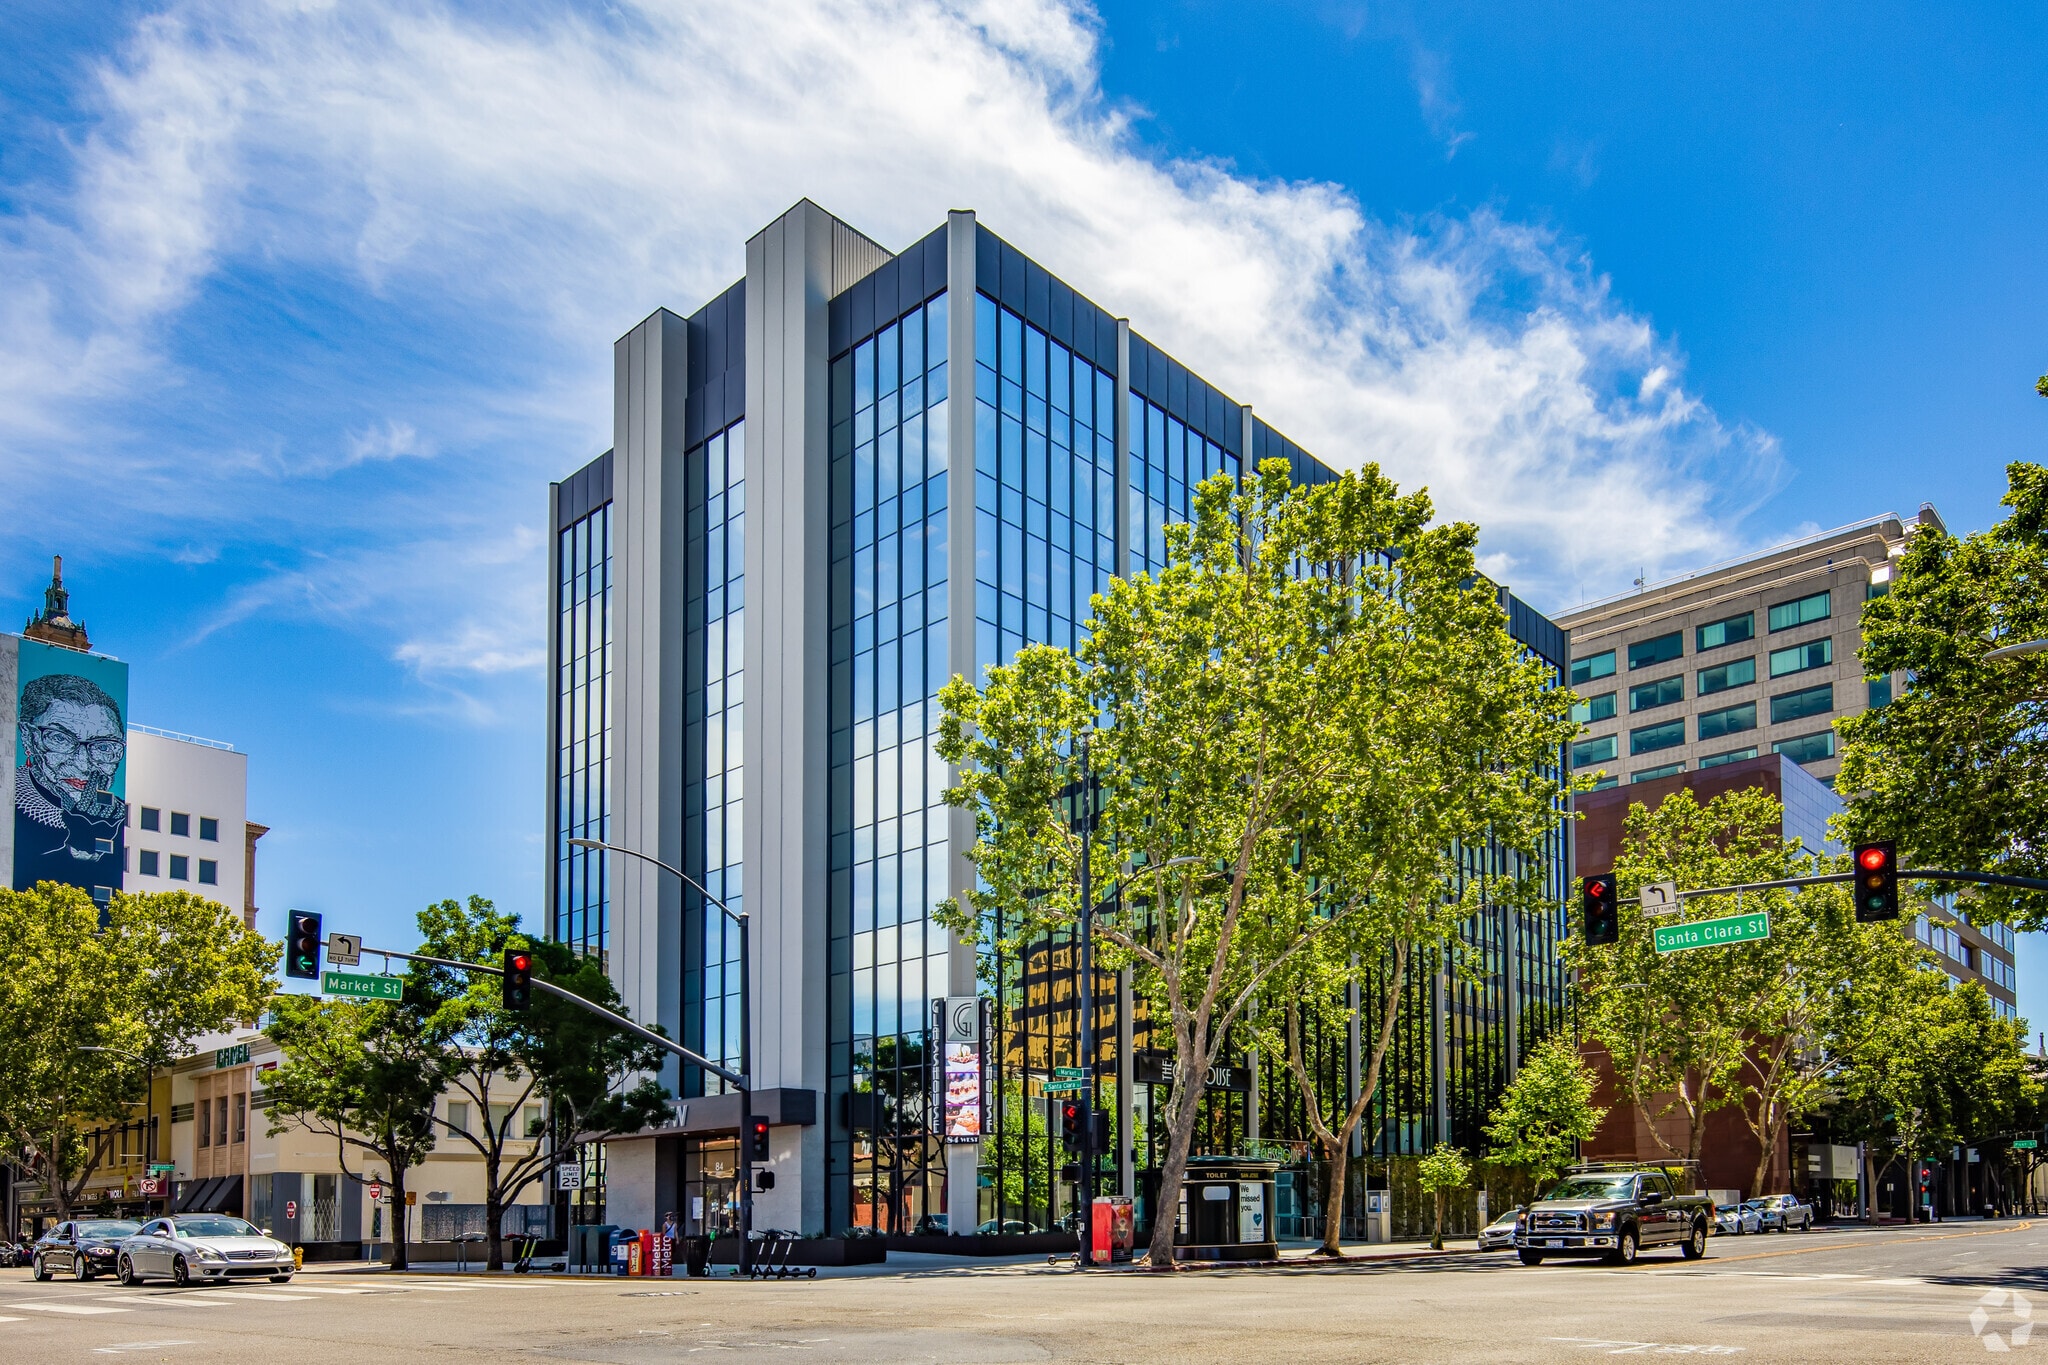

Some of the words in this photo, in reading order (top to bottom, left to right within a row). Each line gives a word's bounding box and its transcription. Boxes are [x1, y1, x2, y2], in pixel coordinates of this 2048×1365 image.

[1658, 931, 1699, 947] Santa
[1704, 924, 1742, 940] Clara
[1748, 919, 1764, 933] St
[329, 978, 375, 993] Market
[383, 982, 399, 995] St
[931, 999, 941, 1134] GLASSHOUSE
[984, 999, 994, 1134] GLASSHOUSE
[1162, 1060, 1173, 1080] THE
[946, 1136, 959, 1144] 84
[715, 1162, 724, 1170] 84
[562, 1177, 580, 1187] 25
[1240, 1194, 1261, 1202] missed
[1240, 1204, 1253, 1212] you.
[652, 1237, 661, 1269] Metro
[661, 1235, 672, 1269] Metro
